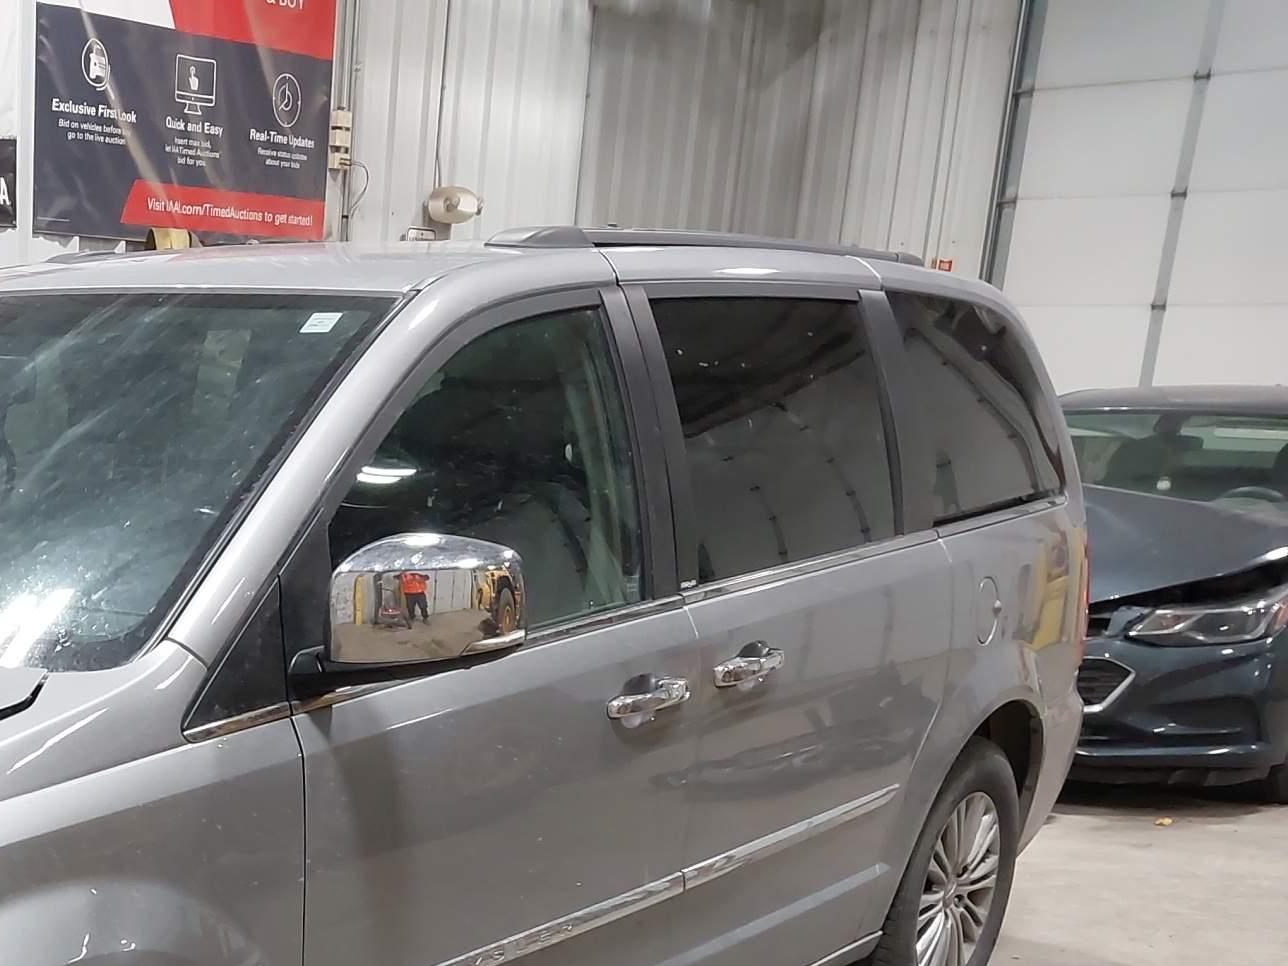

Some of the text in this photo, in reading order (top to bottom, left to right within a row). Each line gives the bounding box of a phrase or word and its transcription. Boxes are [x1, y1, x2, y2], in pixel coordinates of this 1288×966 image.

[52, 98, 97, 116] Exclusive
[98, 104, 118, 119] First
[71, 121, 79, 129] on
[166, 116, 224, 138] Quick and Easy
[67, 131, 76, 140] go
[84, 132, 94, 140] the
[94, 133, 104, 142] live
[250, 128, 315, 148] Real-Time Updates
[147, 197, 165, 212] Visit
[264, 212, 273, 222] to
[274, 213, 287, 226] get
